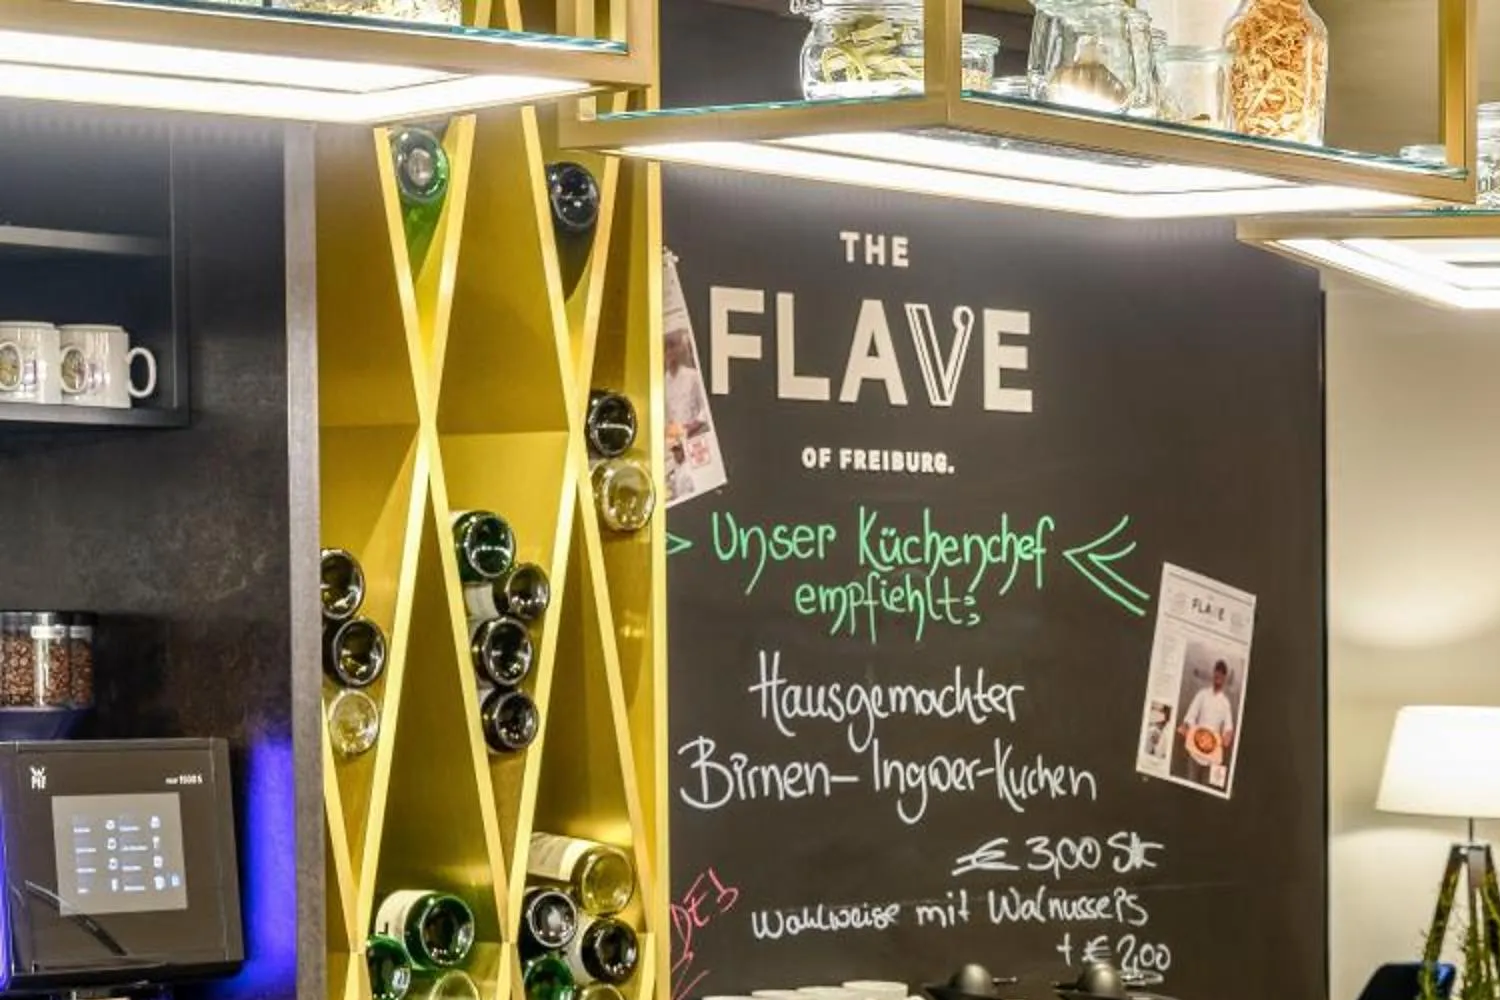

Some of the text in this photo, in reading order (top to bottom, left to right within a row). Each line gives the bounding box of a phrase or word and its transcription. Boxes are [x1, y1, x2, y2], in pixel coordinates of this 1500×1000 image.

[839, 230, 910, 268] THE
[709, 285, 1034, 413] FLAVE
[801, 446, 956, 475] OF FREIBURG.
[711, 505, 1056, 597] Unser Küchenchef
[1190, 596, 1226, 622] FLAE
[748, 649, 1026, 753] Hausgemachter
[1024, 835, 1102, 880] 3,00
[915, 888, 971, 928] mit
[987, 885, 1149, 926] Walnusseis
